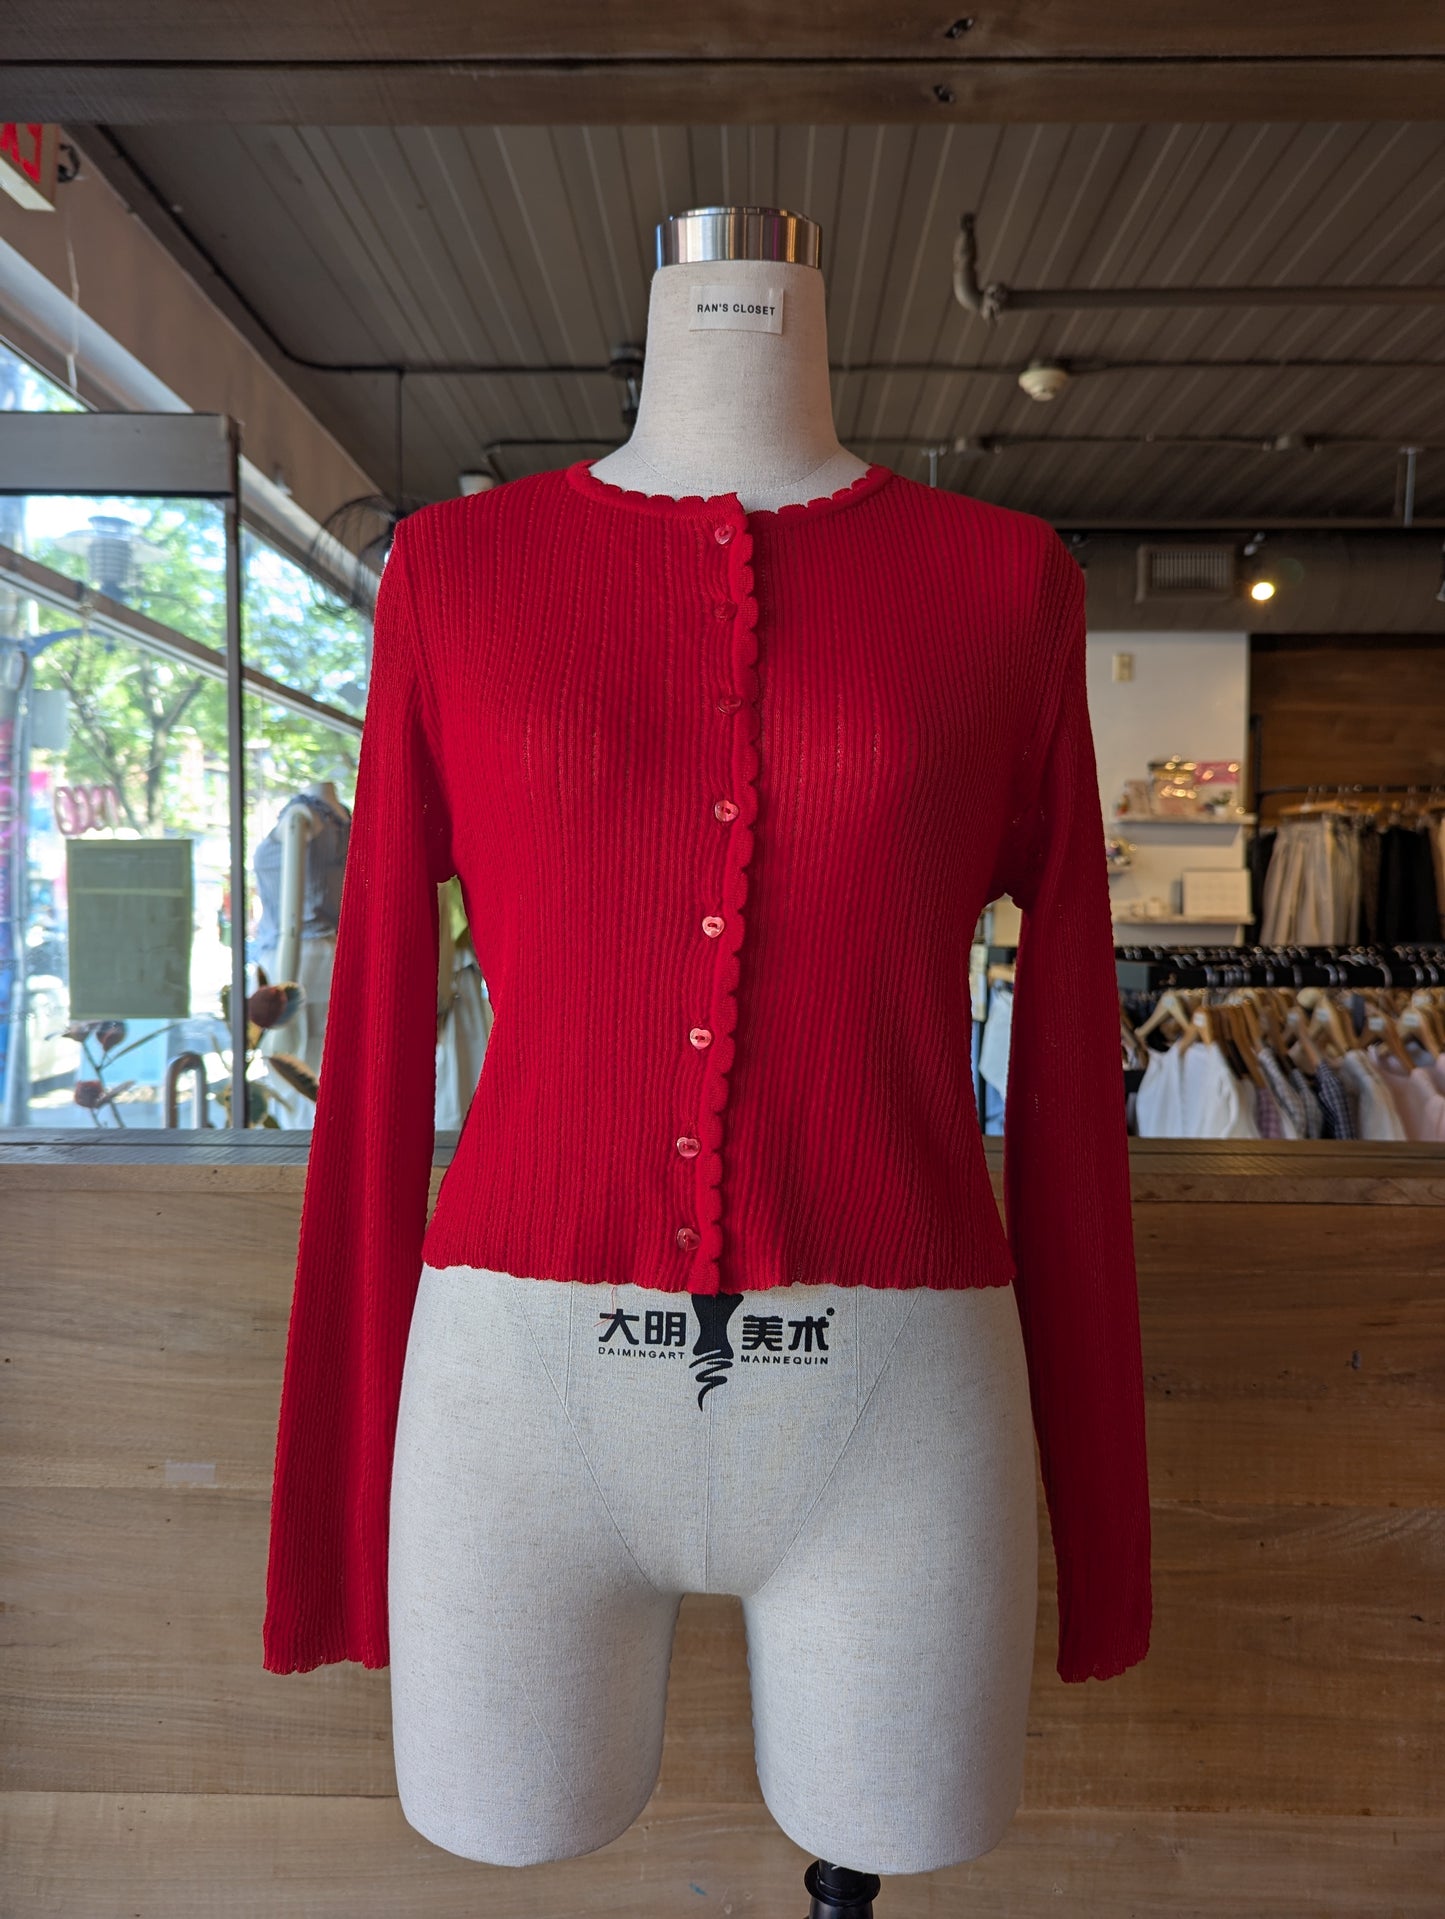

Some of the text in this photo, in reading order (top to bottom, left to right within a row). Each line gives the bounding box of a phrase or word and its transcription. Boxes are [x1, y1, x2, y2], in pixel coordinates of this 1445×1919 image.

[697, 303, 776, 316] RAN'S CLOSET
[598, 1307, 835, 1353] 大明 美术
[598, 1346, 830, 1366] DAIMINGART MANNEQUIN
